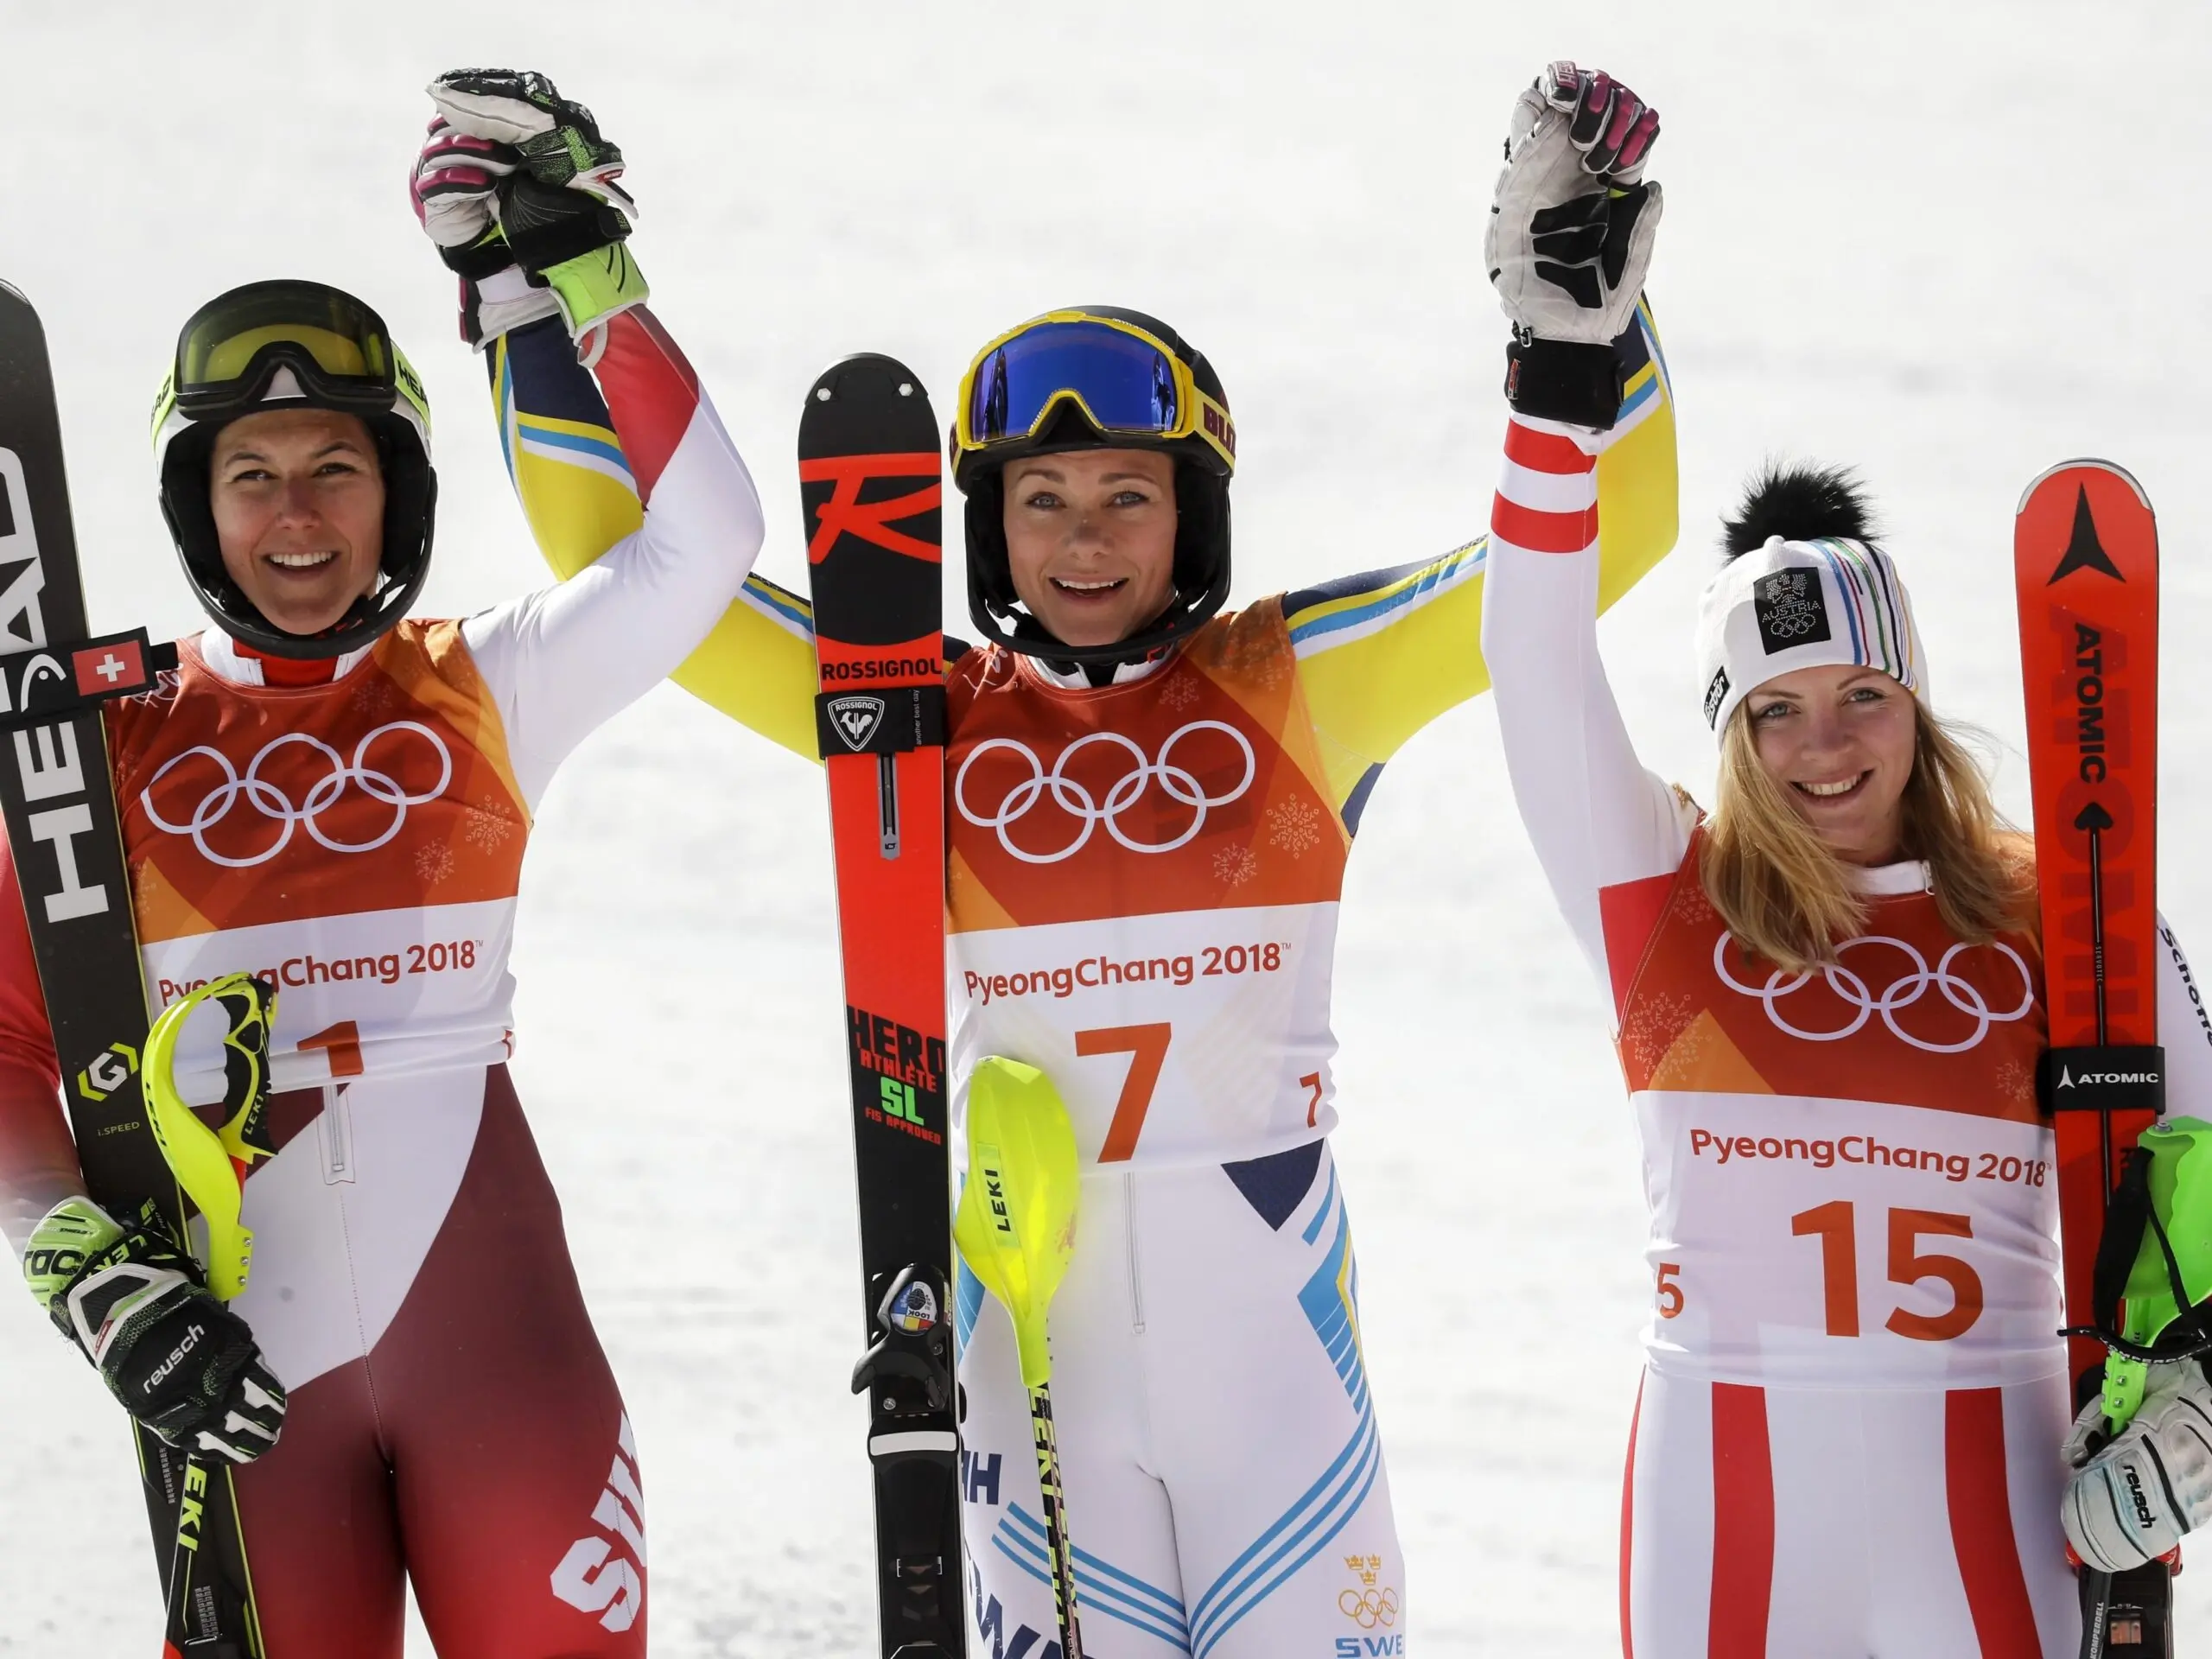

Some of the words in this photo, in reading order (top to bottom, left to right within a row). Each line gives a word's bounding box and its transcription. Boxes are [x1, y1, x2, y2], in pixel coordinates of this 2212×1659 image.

[1762, 601, 1821, 624] AUSTRIA
[821, 658, 942, 681] ROSSIGNOL
[835, 702, 878, 712] ROSSIGNOL
[2075, 621, 2107, 785] ATOMIC
[159, 955, 400, 1007] PyegChang
[406, 940, 476, 974] 2018
[964, 954, 1194, 1006] PyeongChang
[1201, 943, 1281, 977] 2018
[296, 1020, 365, 1077] 1
[860, 1048, 938, 1093] ATHLETE
[880, 1077, 925, 1126] SL
[1075, 1021, 1172, 1164] 7
[1299, 1071, 1323, 1128] 7
[2077, 1071, 2159, 1085] ATOMIC
[97, 1122, 141, 1137] i.SPEED
[244, 1092, 265, 1136] LEKI
[865, 1107, 882, 1122] FIS
[886, 1116, 942, 1146] APPROVED
[1689, 1128, 1971, 1183] PyeongChang
[1976, 1153, 2045, 1188] 2018
[984, 1169, 1011, 1232] LEKI
[1791, 1200, 1984, 1342] 15
[143, 1324, 205, 1395] reusch
[178, 1454, 207, 1552] EKI
[2122, 1465, 2157, 1529] reusch
[1335, 1634, 1403, 1658] SWE
[2088, 1601, 2106, 1659] KOMPERDELL
